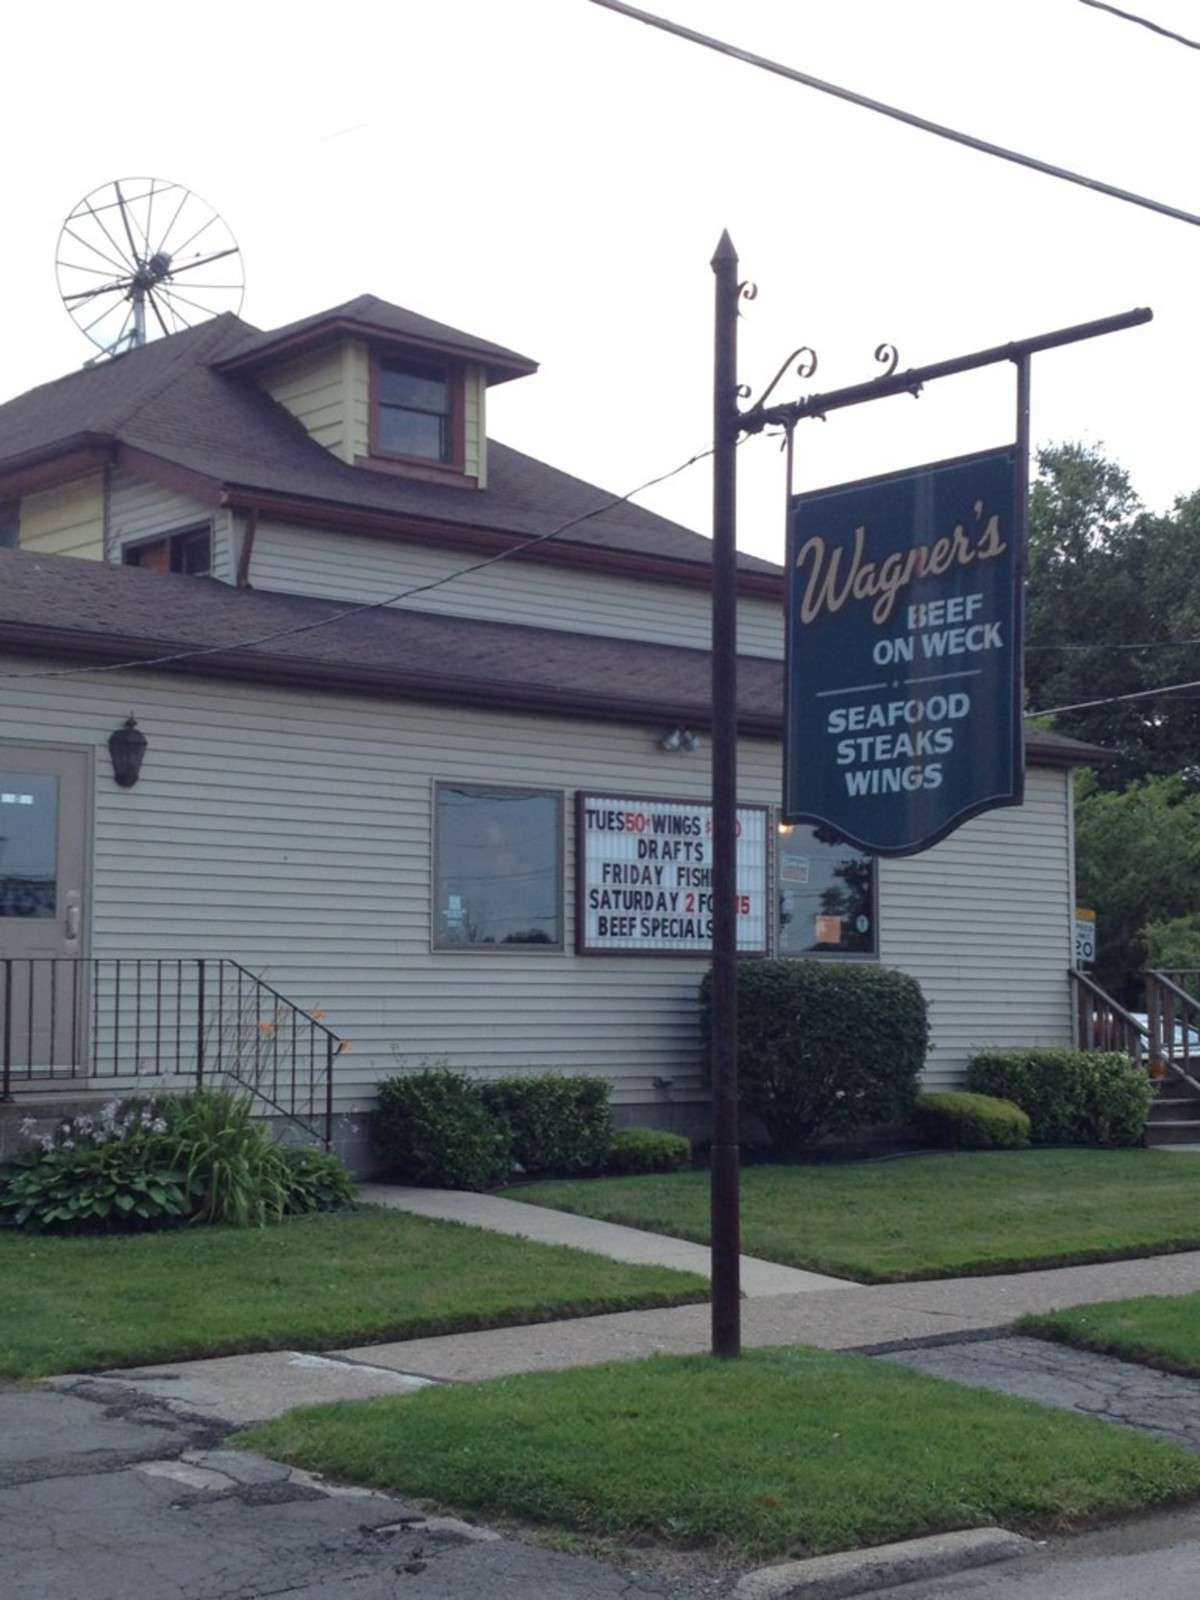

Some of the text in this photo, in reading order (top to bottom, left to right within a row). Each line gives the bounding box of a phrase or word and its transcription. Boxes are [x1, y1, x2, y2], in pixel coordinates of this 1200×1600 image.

[797, 499, 1006, 625] Wagner's
[907, 593, 984, 630] BEEF
[873, 621, 1003, 665] ON WECK
[827, 692, 970, 733] SEAFOOD
[836, 728, 954, 765] STEAKS
[845, 762, 943, 797] WINGS
[651, 813, 701, 836] WINGS
[638, 838, 704, 862] DRAFTS
[602, 863, 663, 885] FRIDAY
[589, 889, 679, 912] SATURDAY
[685, 892, 695, 913] 2
[598, 915, 714, 940] BEEF SPECIALS
